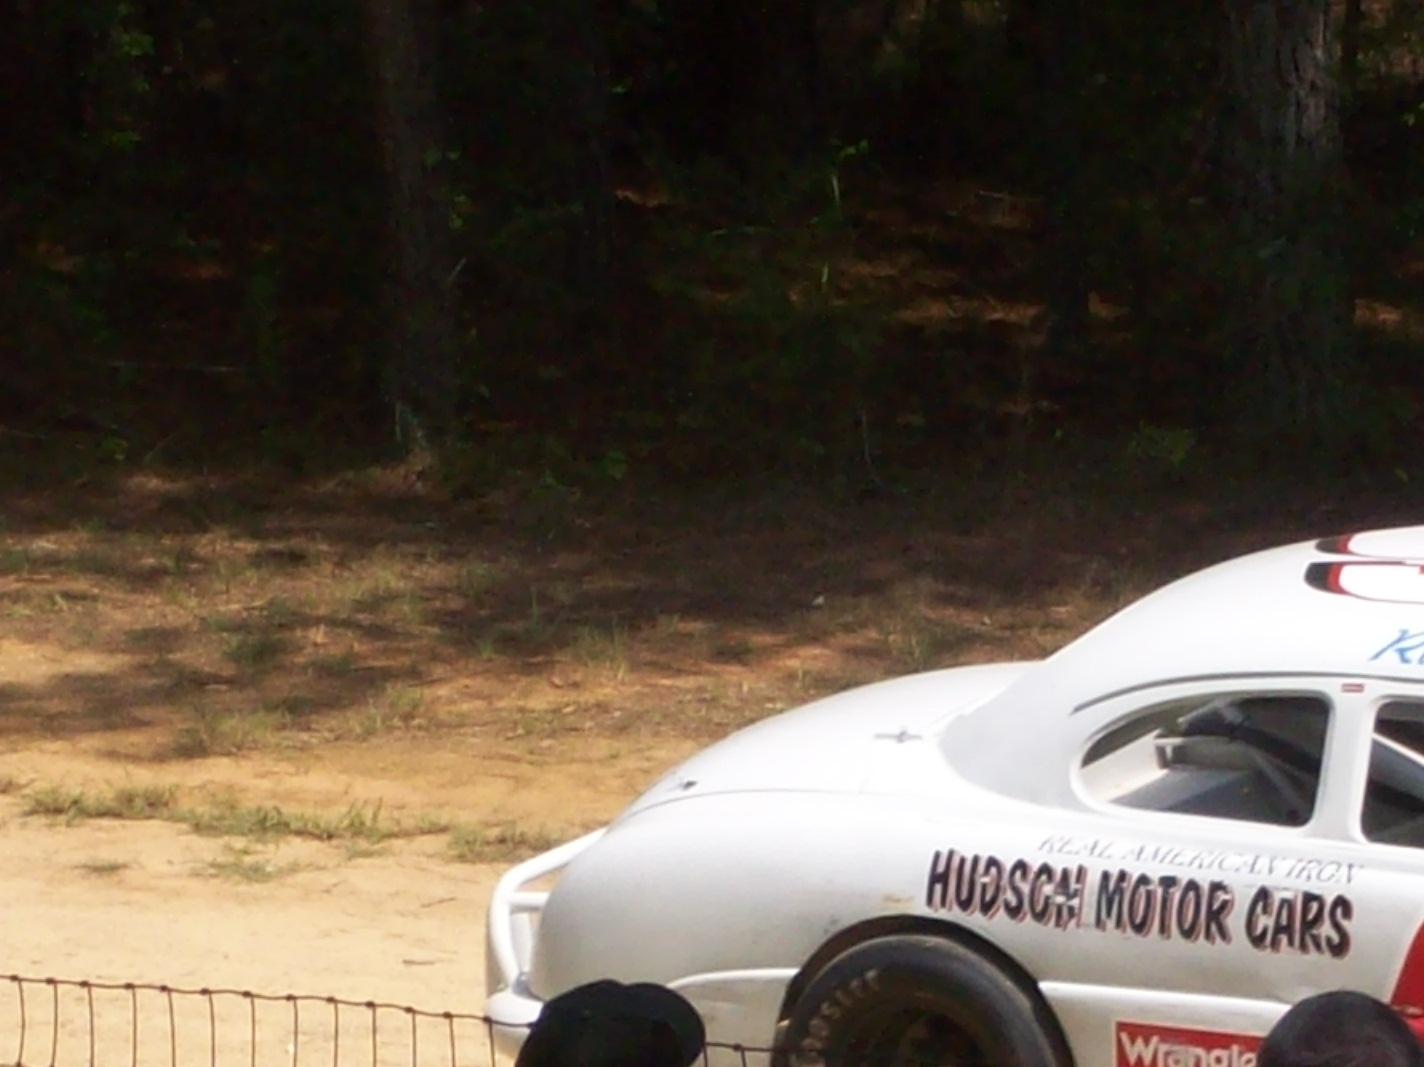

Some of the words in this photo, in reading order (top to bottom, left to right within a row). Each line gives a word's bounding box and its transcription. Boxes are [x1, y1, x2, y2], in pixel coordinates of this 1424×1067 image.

[1038, 834, 1115, 858] REAL
[1123, 843, 1284, 876] AMERICAN
[1284, 857, 1366, 885] IRON
[925, 848, 1088, 931] HUDSON
[1094, 868, 1233, 945] MOTOR
[1244, 884, 1355, 959] CARS
